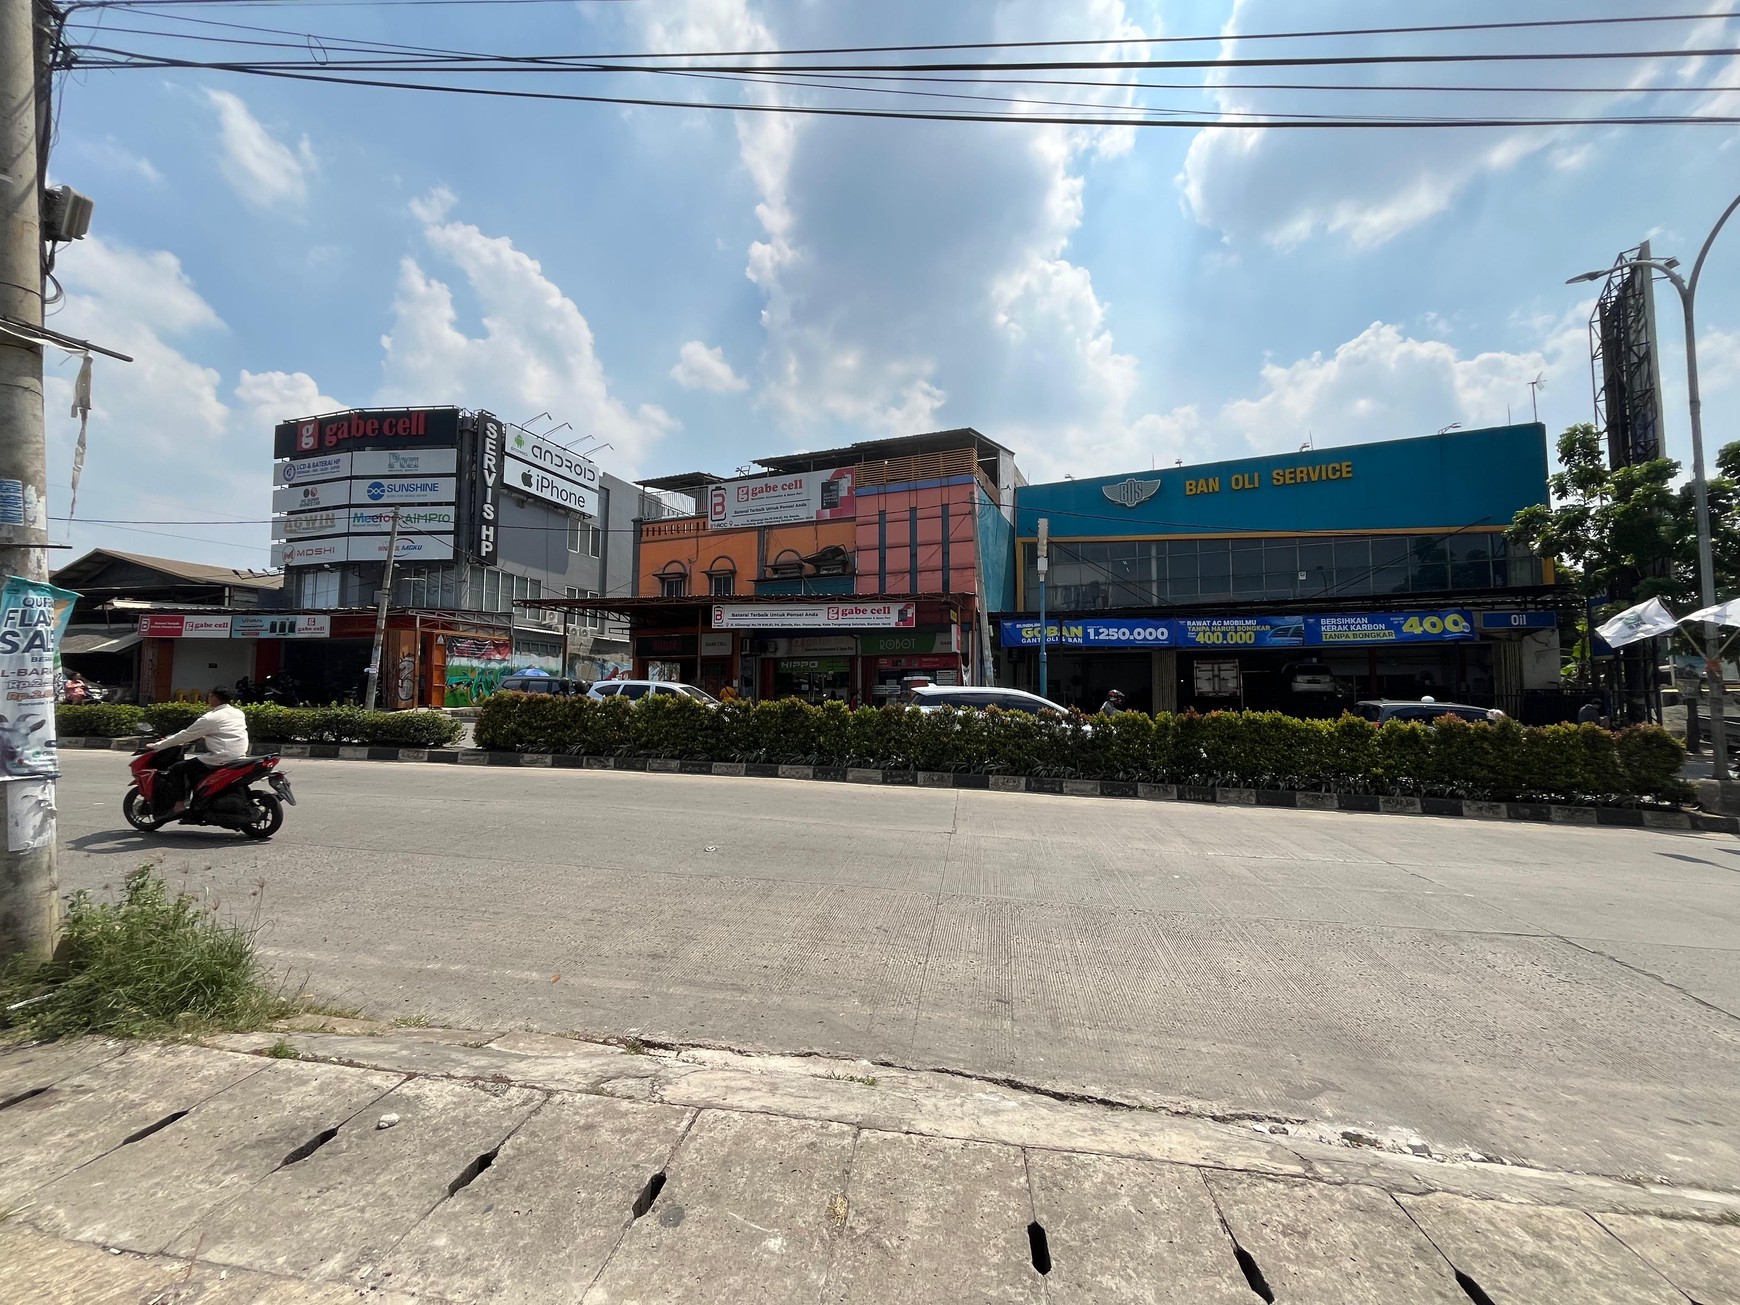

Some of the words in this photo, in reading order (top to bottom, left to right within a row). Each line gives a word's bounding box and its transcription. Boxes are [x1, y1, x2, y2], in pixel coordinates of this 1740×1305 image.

[325, 414, 379, 447] gabe
[383, 412, 426, 436] cell
[482, 422, 498, 520] SERVIS
[1185, 476, 1220, 496] BAN
[1231, 472, 1260, 490] OLI
[1272, 462, 1352, 486] SERVICE
[386, 482, 439, 492] SUNSHINE
[536, 474, 586, 508] iPhone
[751, 483, 778, 498] gabe
[781, 479, 803, 491] cell
[1120, 480, 1144, 504] BOS
[480, 524, 494, 557] HP
[296, 546, 335, 557] MOSHI
[841, 606, 868, 617] gabe
[870, 606, 891, 615] cell
[1402, 614, 1465, 634] 400
[1511, 614, 1527, 626] Oil
[1022, 626, 1082, 638] GOBAN
[1087, 627, 1168, 640] 1.250.000
[1196, 632, 1255, 644] 400.000
[880, 638, 916, 650] ROBOT
